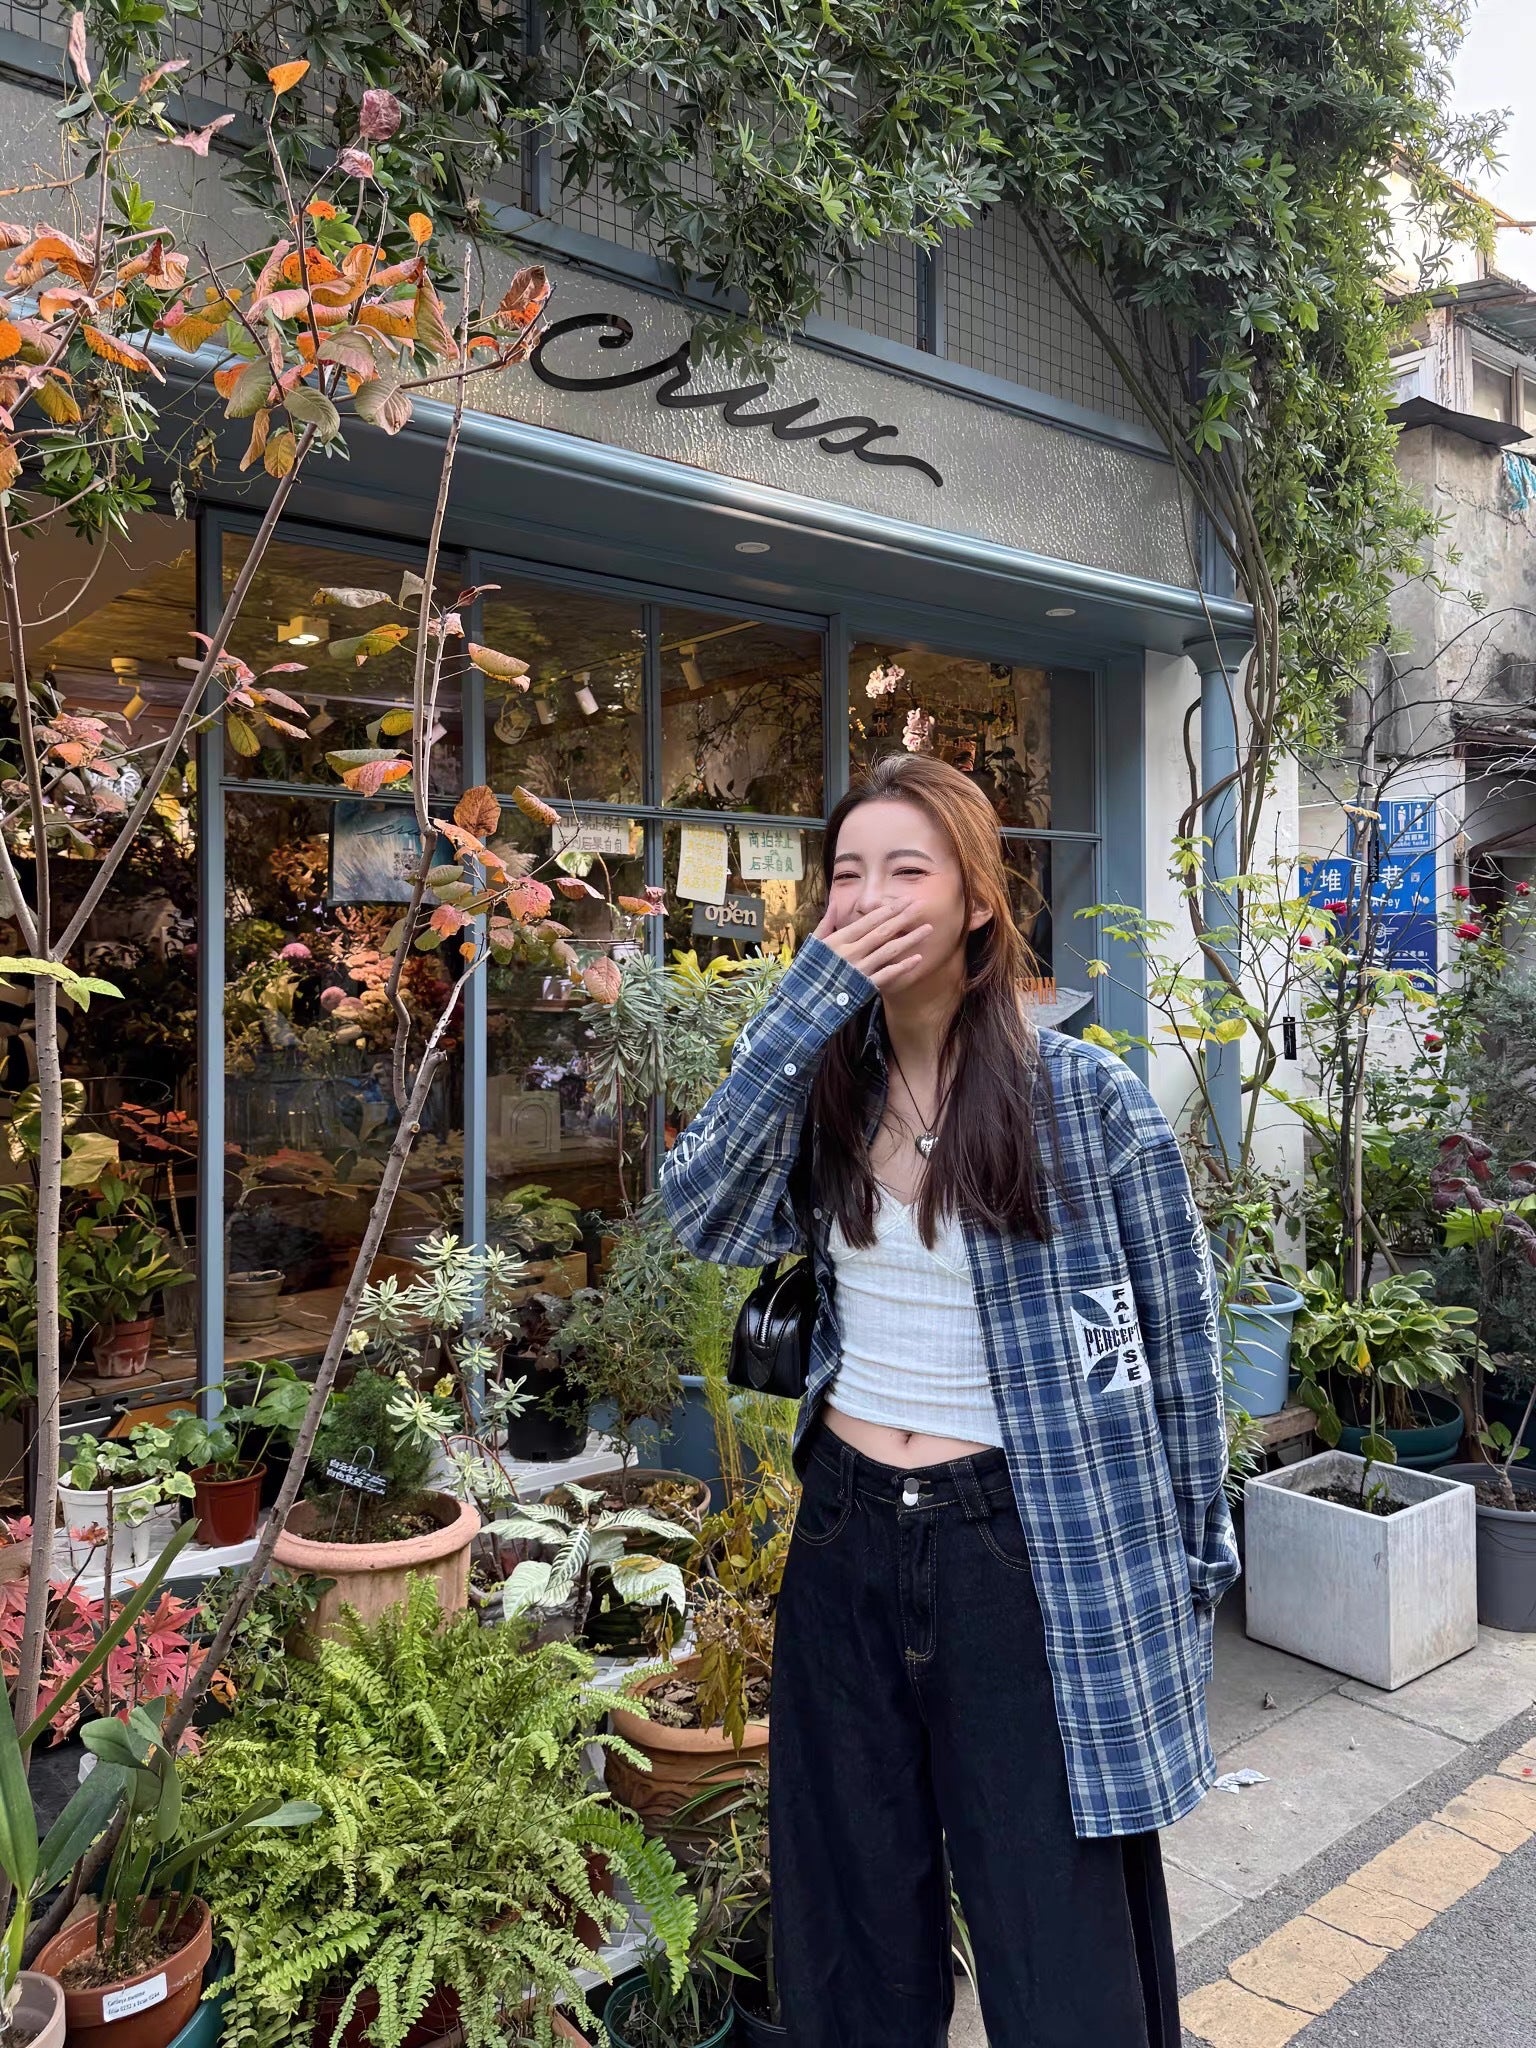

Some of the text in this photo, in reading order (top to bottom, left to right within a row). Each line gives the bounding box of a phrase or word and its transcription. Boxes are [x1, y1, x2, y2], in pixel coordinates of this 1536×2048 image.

[748, 829, 794, 848] 商拍禁止
[749, 855, 794, 872] 后果自负
[704, 903, 757, 927] open
